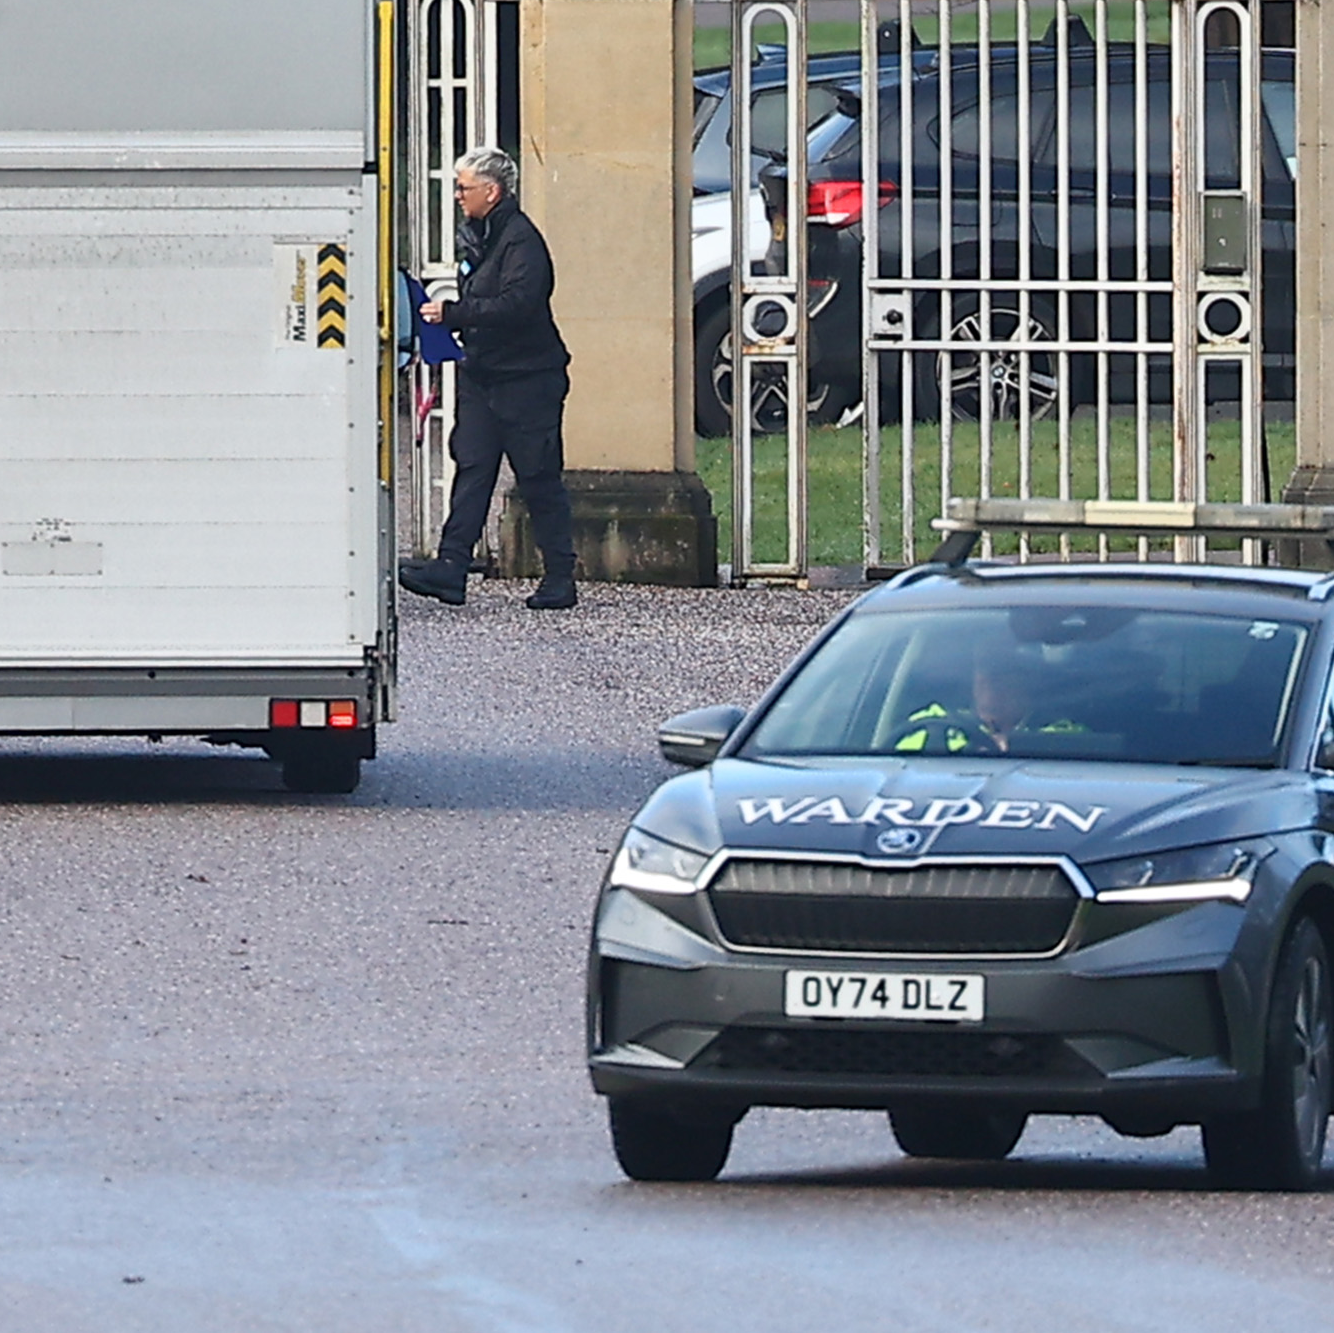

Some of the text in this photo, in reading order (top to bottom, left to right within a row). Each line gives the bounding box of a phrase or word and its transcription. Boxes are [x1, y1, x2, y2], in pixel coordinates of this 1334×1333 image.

[737, 797, 1109, 832] WARDEN
[802, 977, 967, 1011] OY74 DLZ
